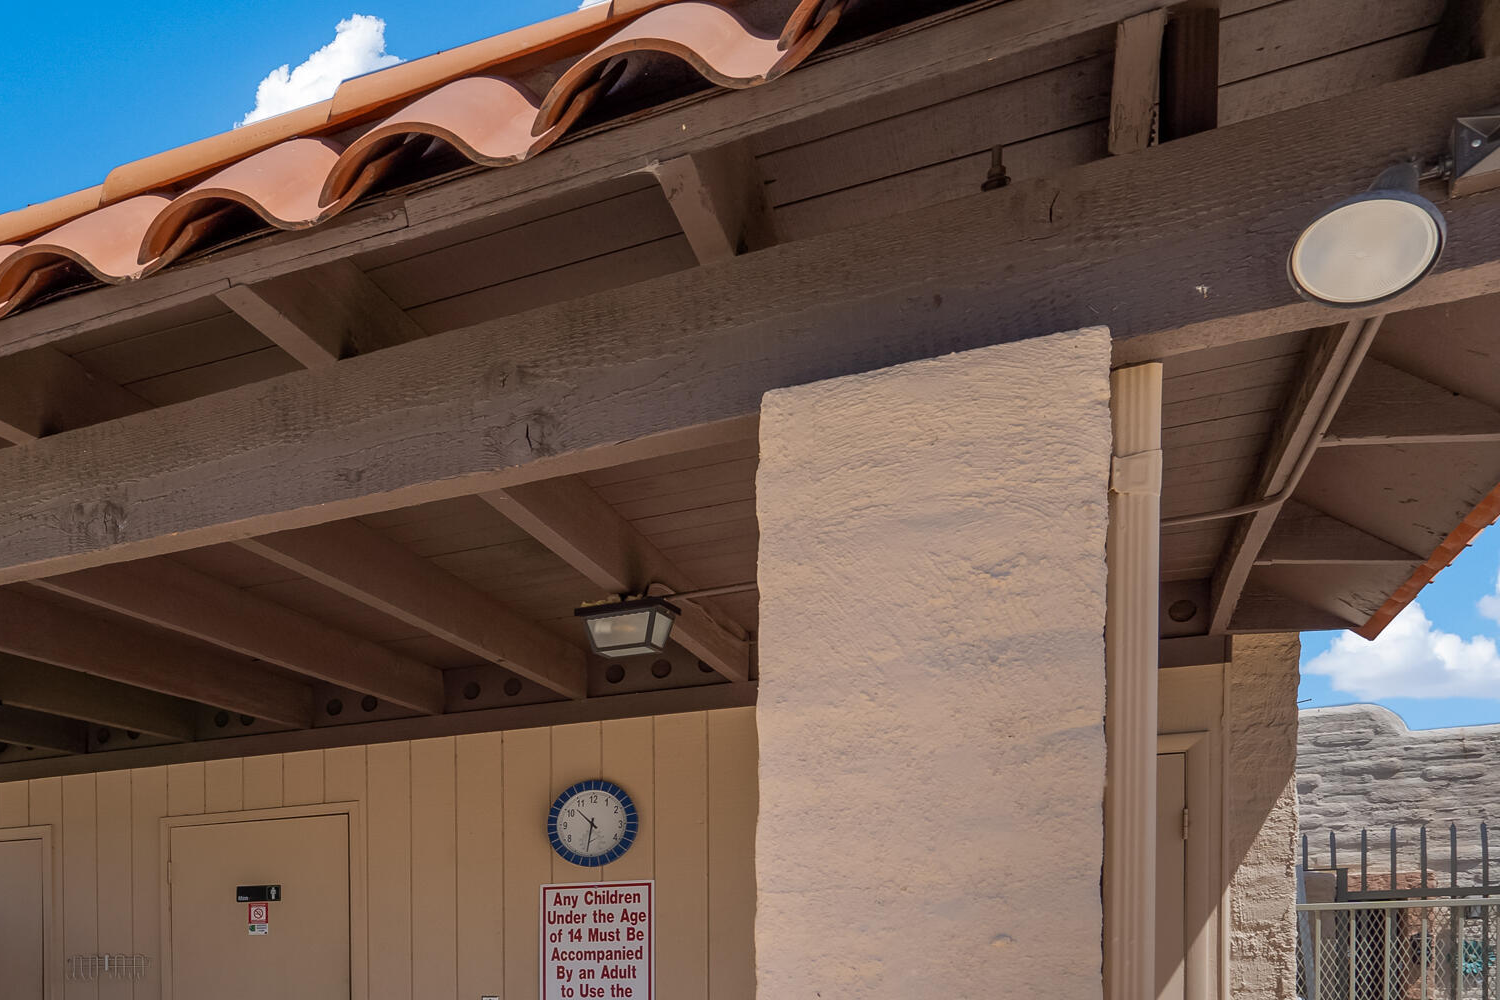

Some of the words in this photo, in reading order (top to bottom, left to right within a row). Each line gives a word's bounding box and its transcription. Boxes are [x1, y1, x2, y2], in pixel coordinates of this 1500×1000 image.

[605, 798, 608, 806] 1
[568, 809, 575, 817] 10
[553, 892, 578, 908] Any
[584, 891, 641, 905] Children
[548, 911, 587, 925] Under
[593, 910, 614, 923] the
[620, 909, 646, 926] Age
[550, 929, 562, 942] of
[568, 928, 582, 942] 14
[588, 928, 620, 942] Must
[626, 927, 644, 941] Be
[551, 946, 643, 963] Accompanied
[556, 967, 573, 982] By
[579, 968, 595, 979] an
[600, 965, 637, 979] Adult
[561, 985, 574, 998] to
[579, 984, 604, 998] Use
[611, 984, 633, 998] the
